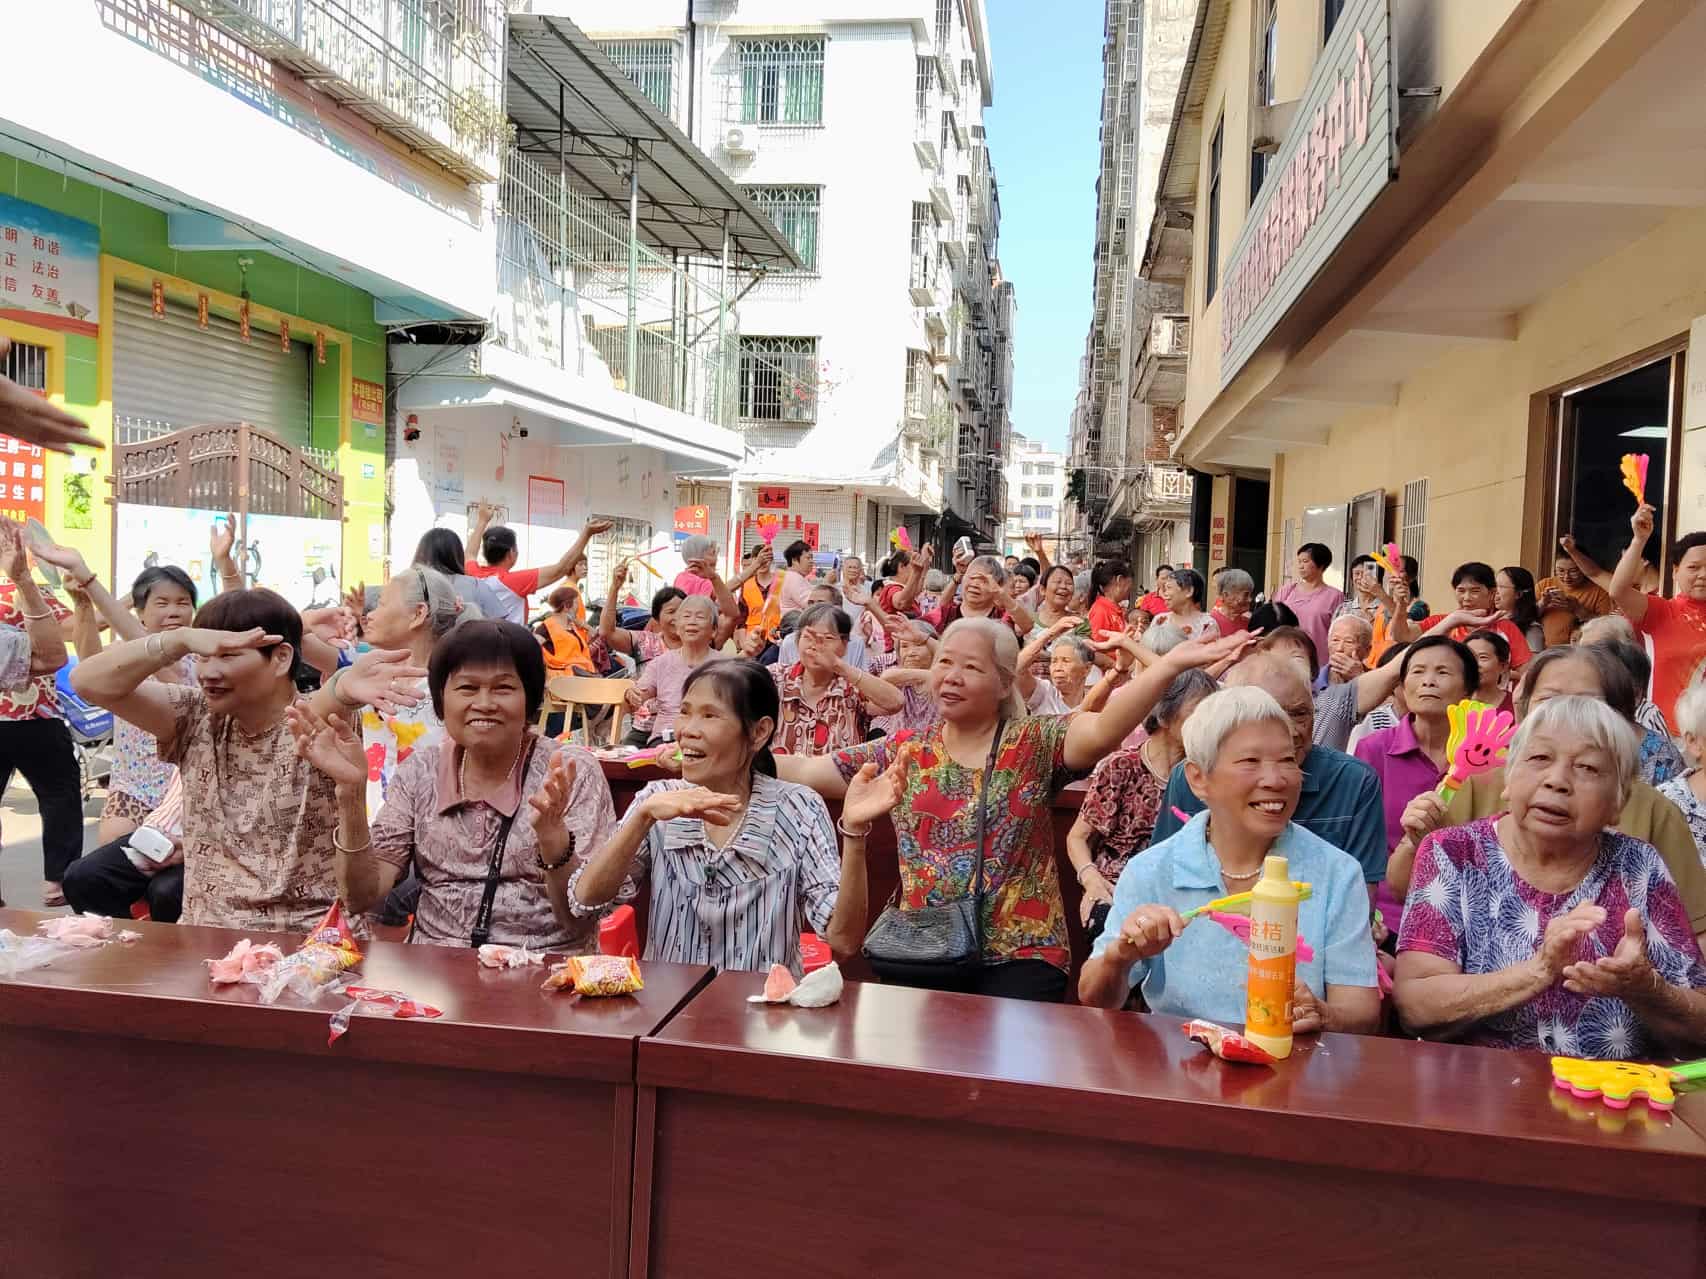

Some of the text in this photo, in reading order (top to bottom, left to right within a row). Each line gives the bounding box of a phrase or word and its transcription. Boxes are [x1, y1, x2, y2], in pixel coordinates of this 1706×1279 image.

[32, 236, 60, 256] 和谐
[32, 260, 59, 280] 法治
[32, 284, 59, 304] 友善
